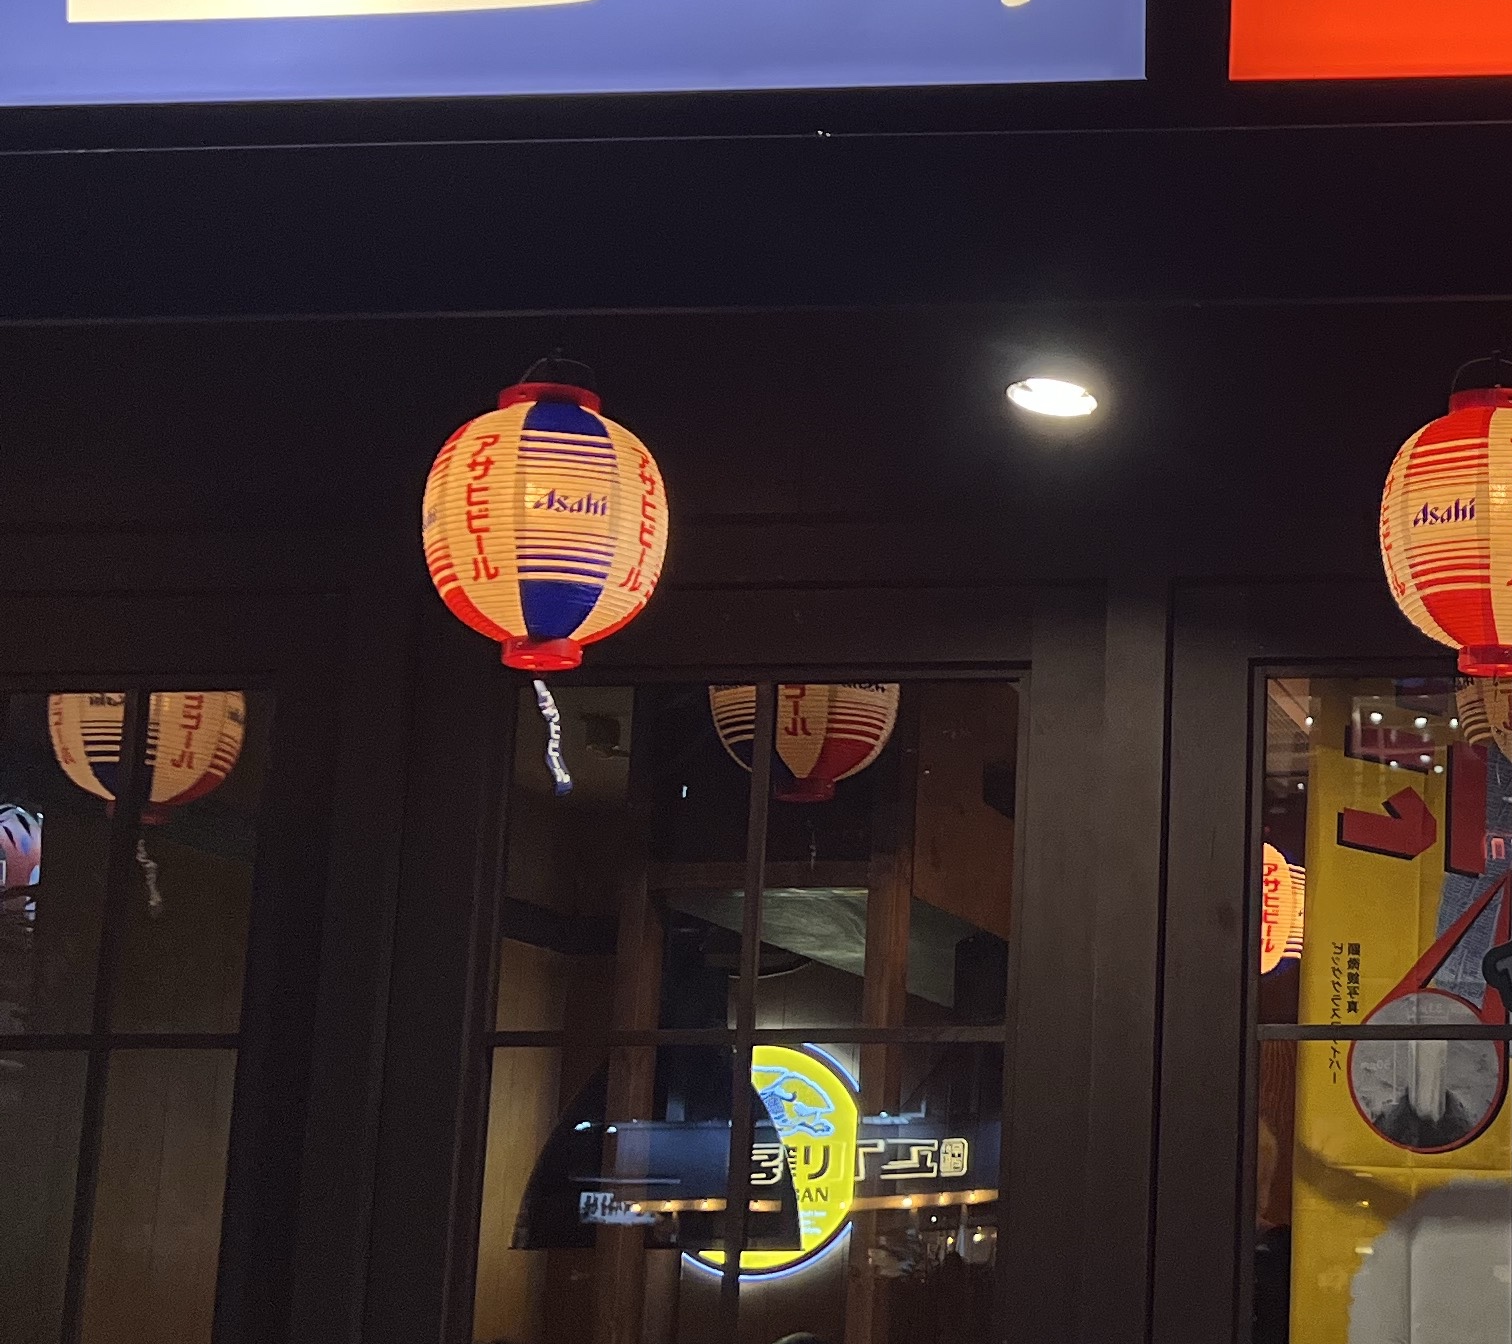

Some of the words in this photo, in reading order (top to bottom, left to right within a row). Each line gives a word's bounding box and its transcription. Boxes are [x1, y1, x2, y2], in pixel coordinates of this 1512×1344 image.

[465, 433, 500, 582] アサヒビール
[532, 488, 609, 517] Asahi
[1412, 497, 1477, 528] Asahi
